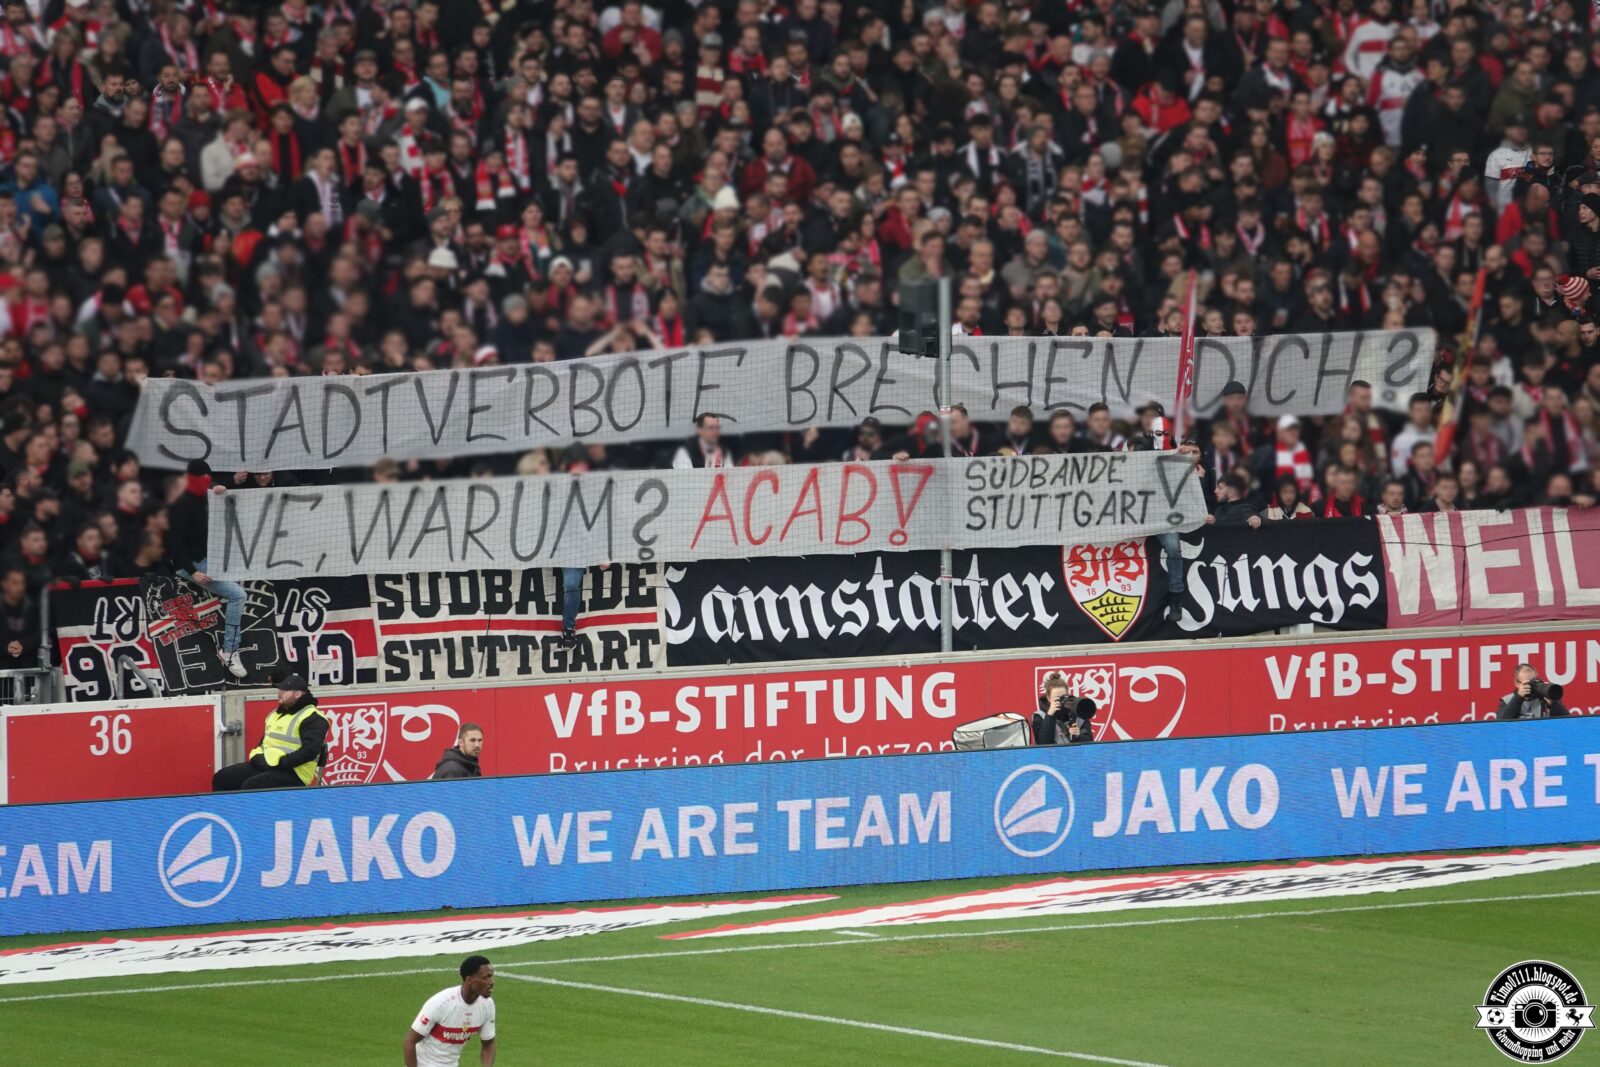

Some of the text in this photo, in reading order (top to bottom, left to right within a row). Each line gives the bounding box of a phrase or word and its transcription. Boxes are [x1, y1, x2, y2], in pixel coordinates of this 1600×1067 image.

[158, 347, 748, 462] STADTVERBOTE
[784, 339, 1145, 425] BRECHEN
[964, 455, 1128, 492] SÜDBANDE
[223, 463, 935, 573] NE, WARUM? ACAB!
[1086, 584, 1133, 597] 18 93
[1377, 507, 1600, 616] WEIL
[383, 628, 660, 682] STUTTGART
[89, 713, 132, 757] 36
[543, 671, 957, 739] VfB-STIFTUNG
[357, 751, 367, 759] 93
[1330, 763, 1427, 819] WE
[1444, 755, 1568, 813] ARE
[512, 790, 952, 868] WE ARE TEAM
[1092, 762, 1280, 838] JAKO
[0, 839, 113, 898] AM
[260, 811, 457, 889] JAKO
